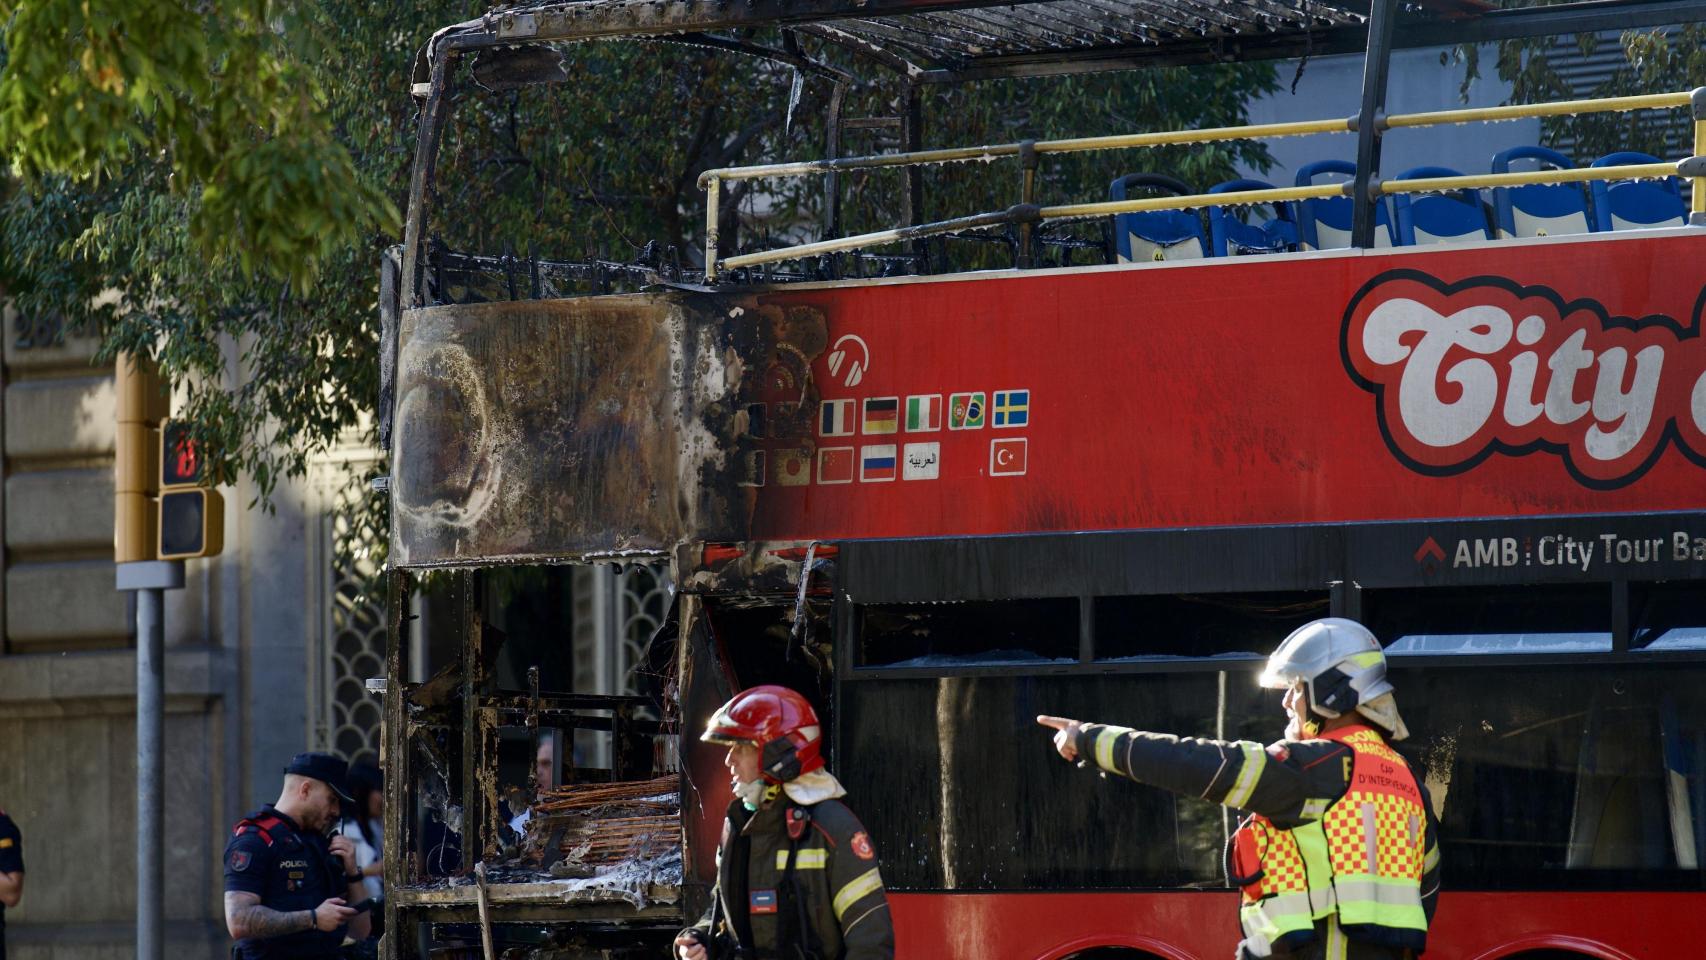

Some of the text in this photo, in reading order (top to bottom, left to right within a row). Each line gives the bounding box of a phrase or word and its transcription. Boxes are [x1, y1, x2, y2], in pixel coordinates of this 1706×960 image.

[1362, 297, 1665, 461] City
[909, 453, 936, 468] العربية
[1453, 537, 1519, 569] AMB
[1538, 534, 1594, 572] City
[1600, 533, 1664, 564] Tour
